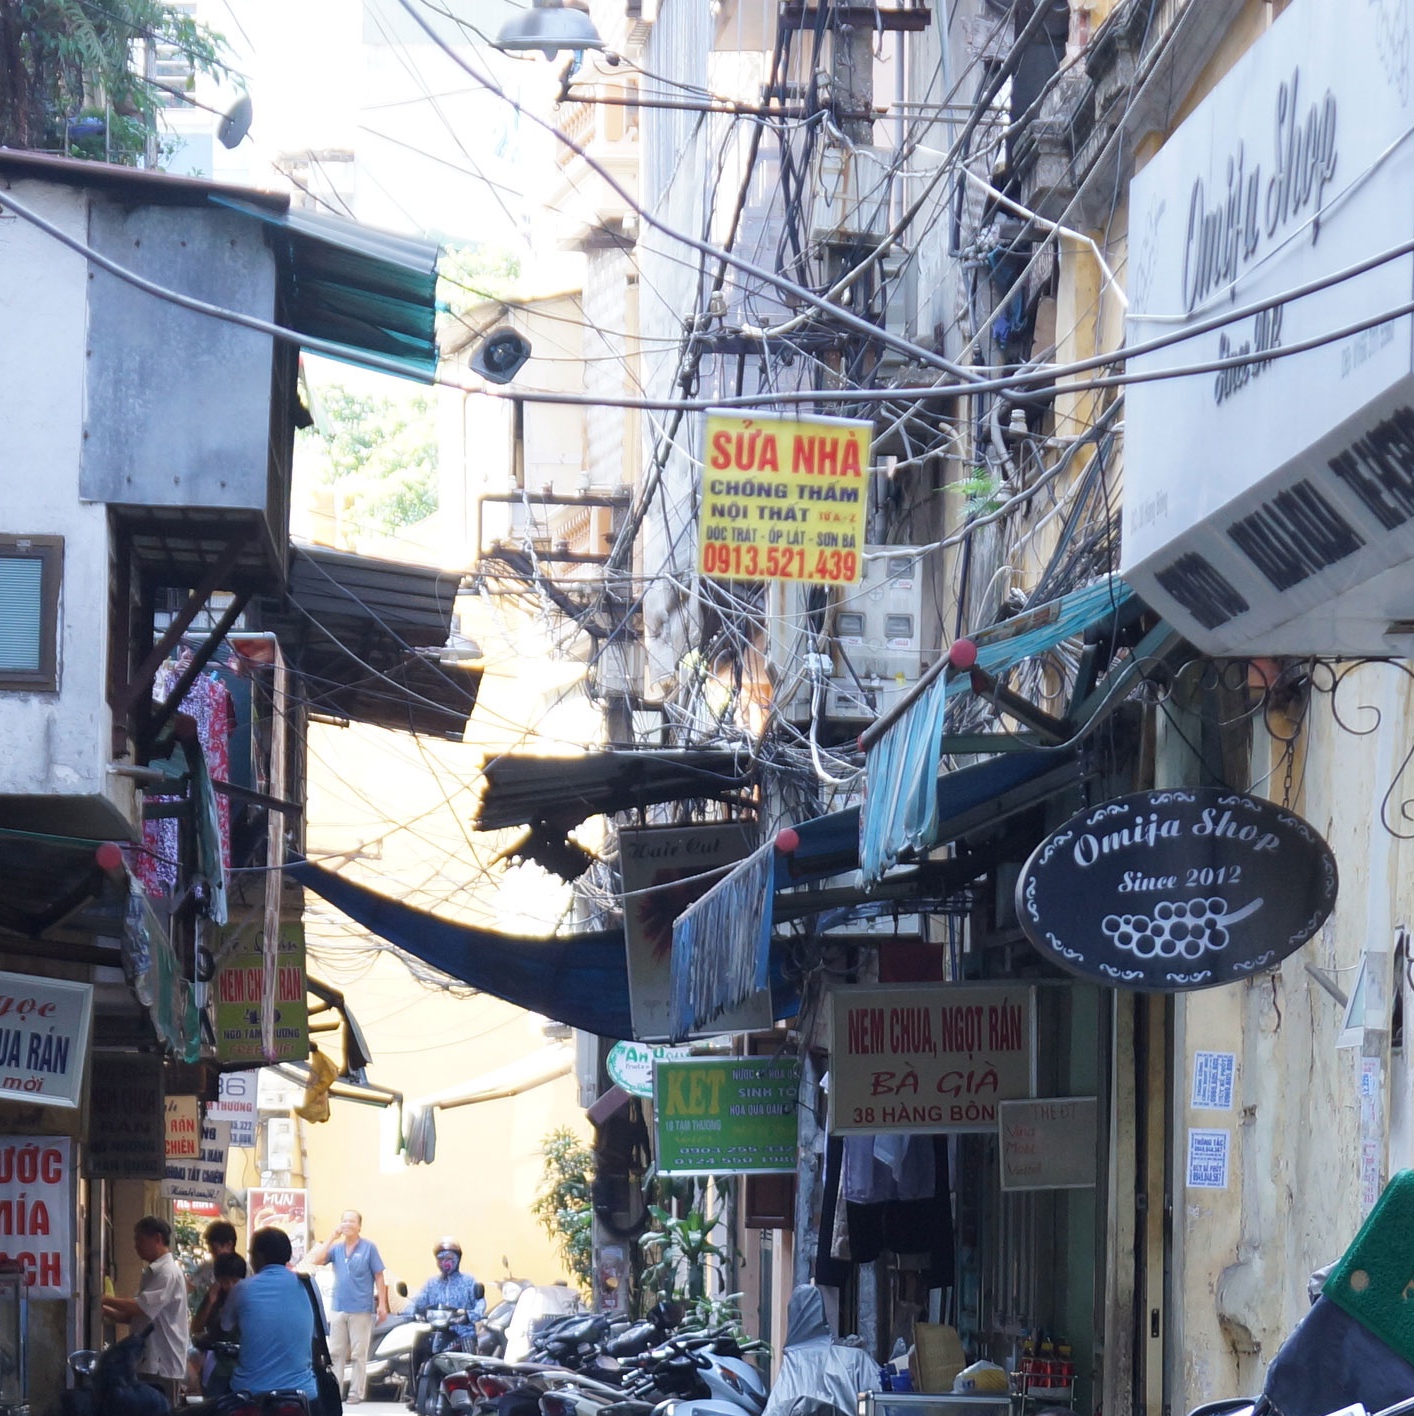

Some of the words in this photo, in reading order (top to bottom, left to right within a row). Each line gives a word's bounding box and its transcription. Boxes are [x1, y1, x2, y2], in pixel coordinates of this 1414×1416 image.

[1266, 65, 1338, 245] Shop
[710, 419, 779, 472] SỬA
[792, 430, 862, 477] NHÀ
[710, 476, 787, 498] CHỐNG
[796, 481, 859, 503] THẤM
[711, 502, 748, 522] NỘI
[756, 502, 810, 522] THẤT
[731, 523, 757, 543] TRÁT
[768, 523, 783, 544] ỐP
[787, 526, 805, 546] LÁT
[816, 531, 838, 547] SƠN
[703, 542, 857, 582] 0913.521.439
[1073, 812, 1182, 867] Omija
[1192, 807, 1280, 855] Shop
[1117, 870, 1178, 893] Since
[1185, 865, 1242, 887] 2012
[219, 969, 244, 1002] NEM
[279, 962, 302, 1001] RÁN
[848, 1009, 885, 1054] NEM
[888, 1007, 937, 1059] CHUA,
[941, 1006, 986, 1066] NGỌT
[988, 991, 1022, 1052] RÁN
[27, 1027, 71, 1075] RÁN
[739, 1088, 772, 1098] SINH
[869, 1065, 921, 1096] BÀ
[935, 1060, 999, 1098] GIÀ
[170, 1115, 194, 1133] RÁN
[853, 1104, 876, 1123] 38
[882, 1097, 942, 1124] HÀNG
[951, 1096, 996, 1121] BÔN
[263, 1192, 293, 1206] MUN
